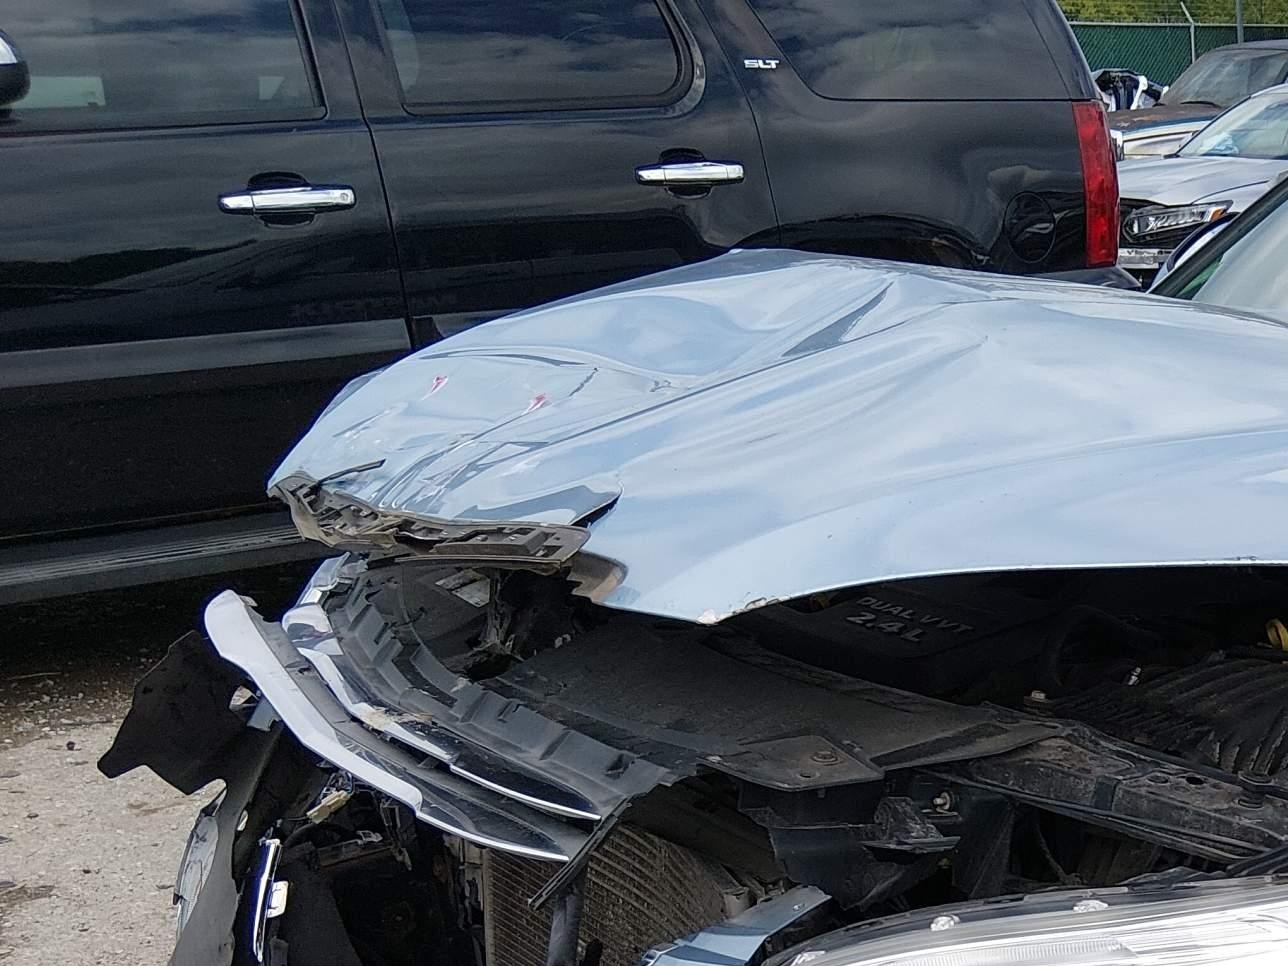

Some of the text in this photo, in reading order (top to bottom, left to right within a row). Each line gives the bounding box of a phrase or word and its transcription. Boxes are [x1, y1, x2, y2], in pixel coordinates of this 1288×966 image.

[743, 59, 780, 69] SLT
[857, 597, 914, 618] DUAL
[845, 612, 921, 642] 2.4L
